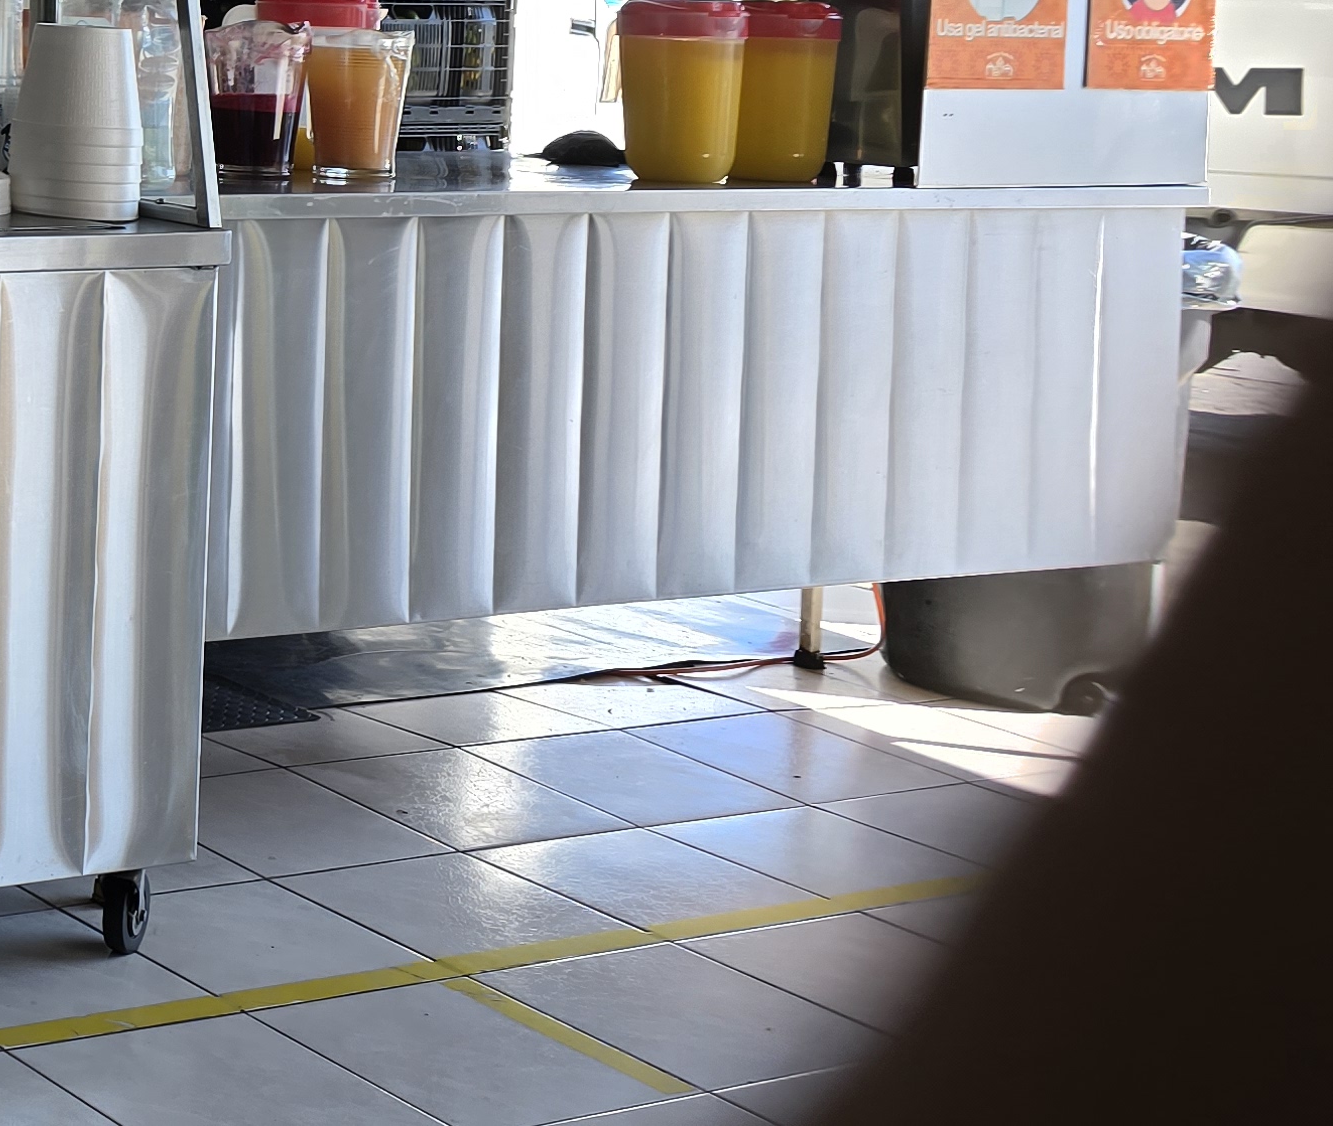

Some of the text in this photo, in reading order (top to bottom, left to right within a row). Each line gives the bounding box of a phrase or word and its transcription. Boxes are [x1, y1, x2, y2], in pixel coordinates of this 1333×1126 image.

[936, 18, 1065, 41] Usa gel antibacterial
